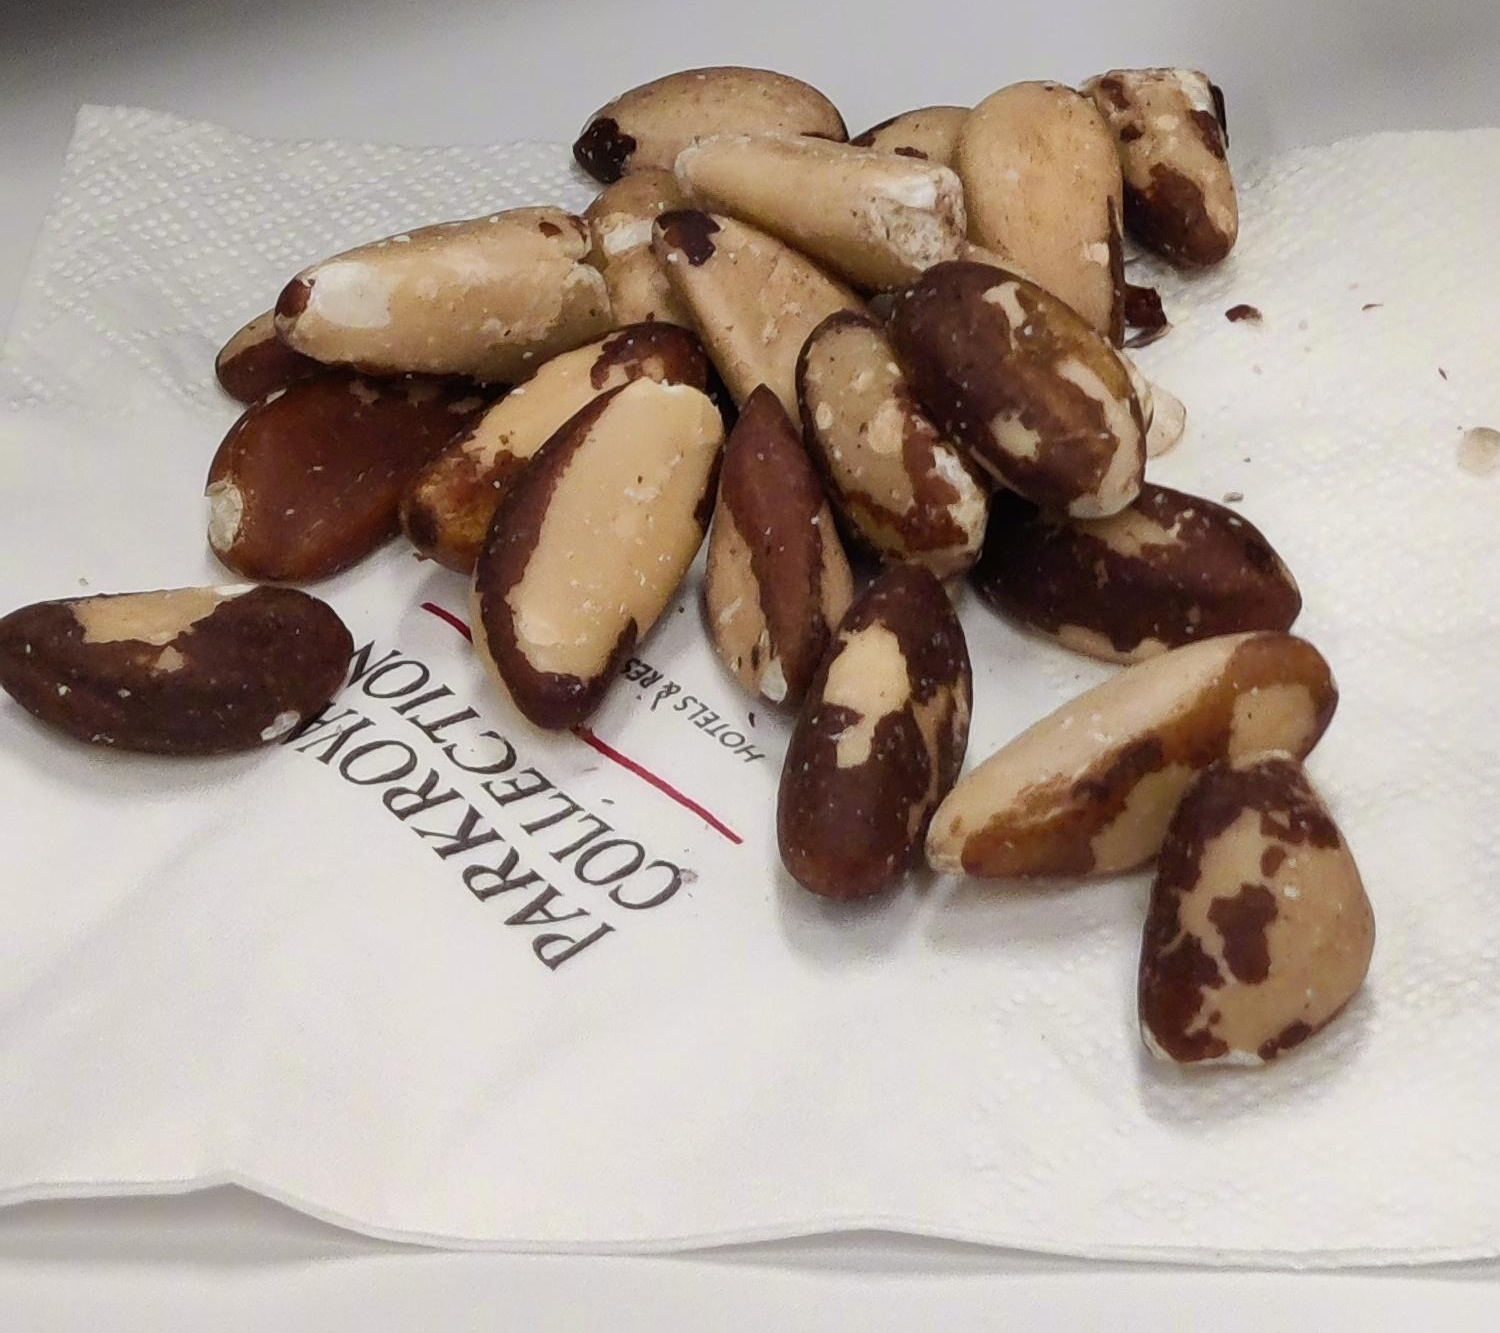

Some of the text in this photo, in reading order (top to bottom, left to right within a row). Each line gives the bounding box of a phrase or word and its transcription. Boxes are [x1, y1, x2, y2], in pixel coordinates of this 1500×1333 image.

[281, 702, 616, 972] PARKROYA
[348, 640, 682, 910] COLLECTION
[622, 658, 766, 762] HOTELS & RES
